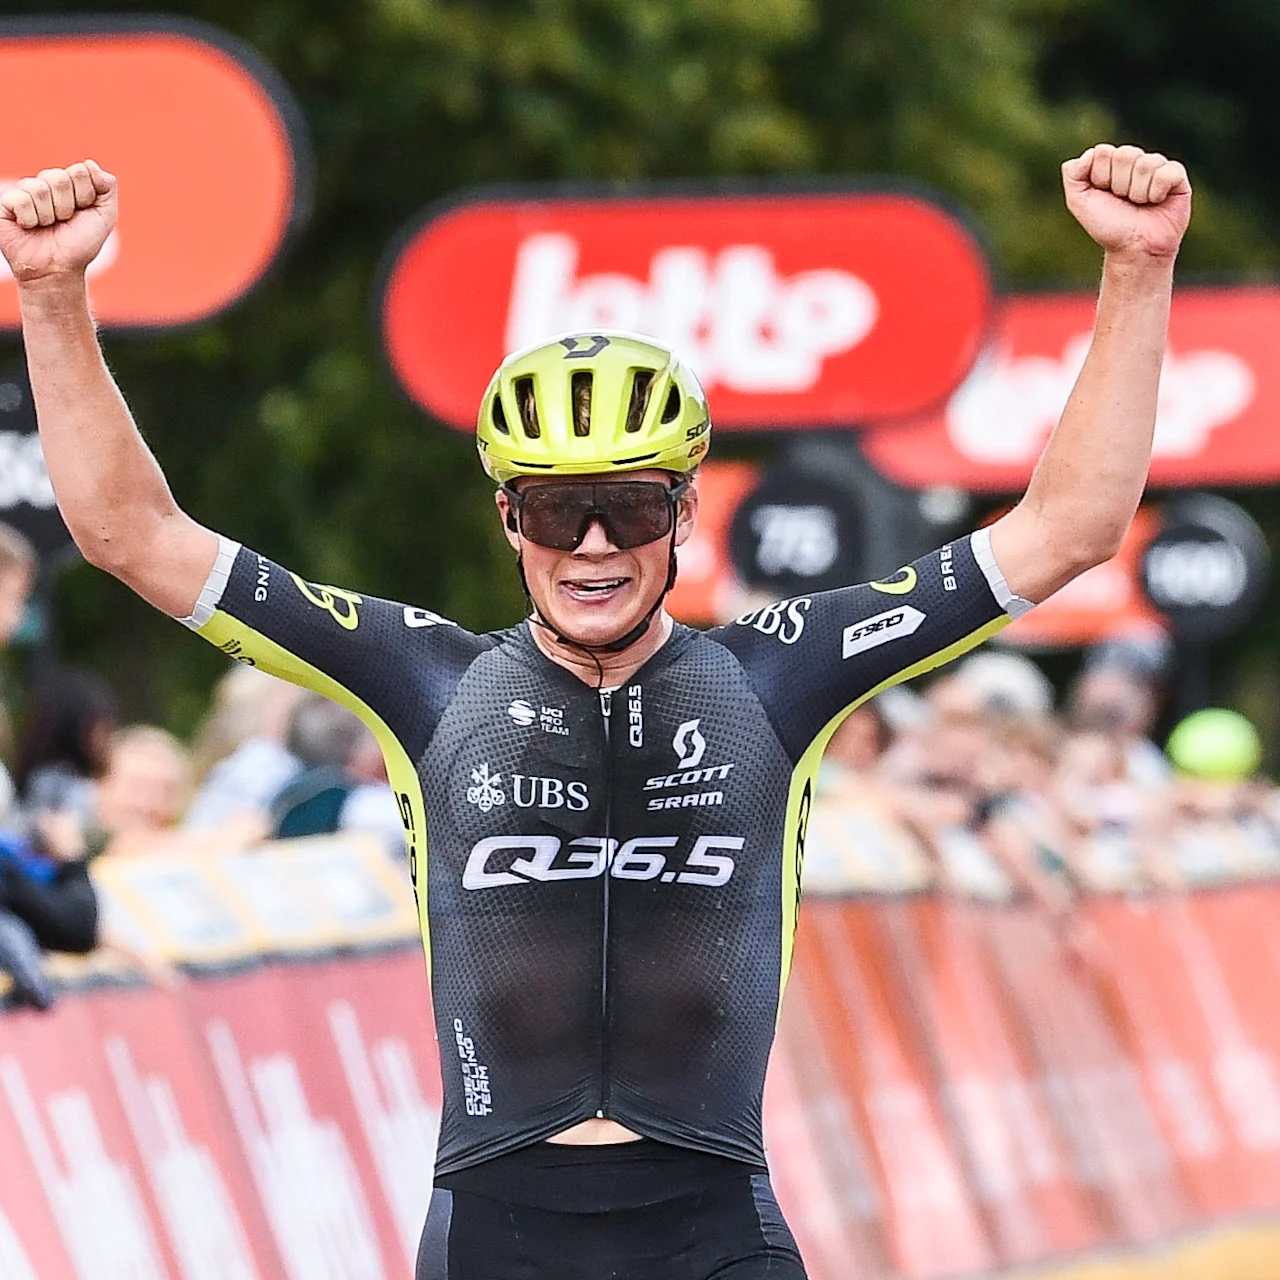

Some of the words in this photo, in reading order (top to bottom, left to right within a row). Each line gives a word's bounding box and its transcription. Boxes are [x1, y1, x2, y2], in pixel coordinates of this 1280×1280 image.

[540, 714, 562, 726] PRO
[541, 706, 563, 718] UCI
[628, 684, 644, 748] Q36.5
[540, 724, 570, 736] TEAM
[510, 774, 590, 811] UBS
[642, 763, 735, 791] SCOTT
[646, 791, 724, 811] SRAM
[462, 834, 746, 891] Q36.5
[464, 1037, 484, 1116] CYCLING
[479, 1065, 493, 1116] TEAM
